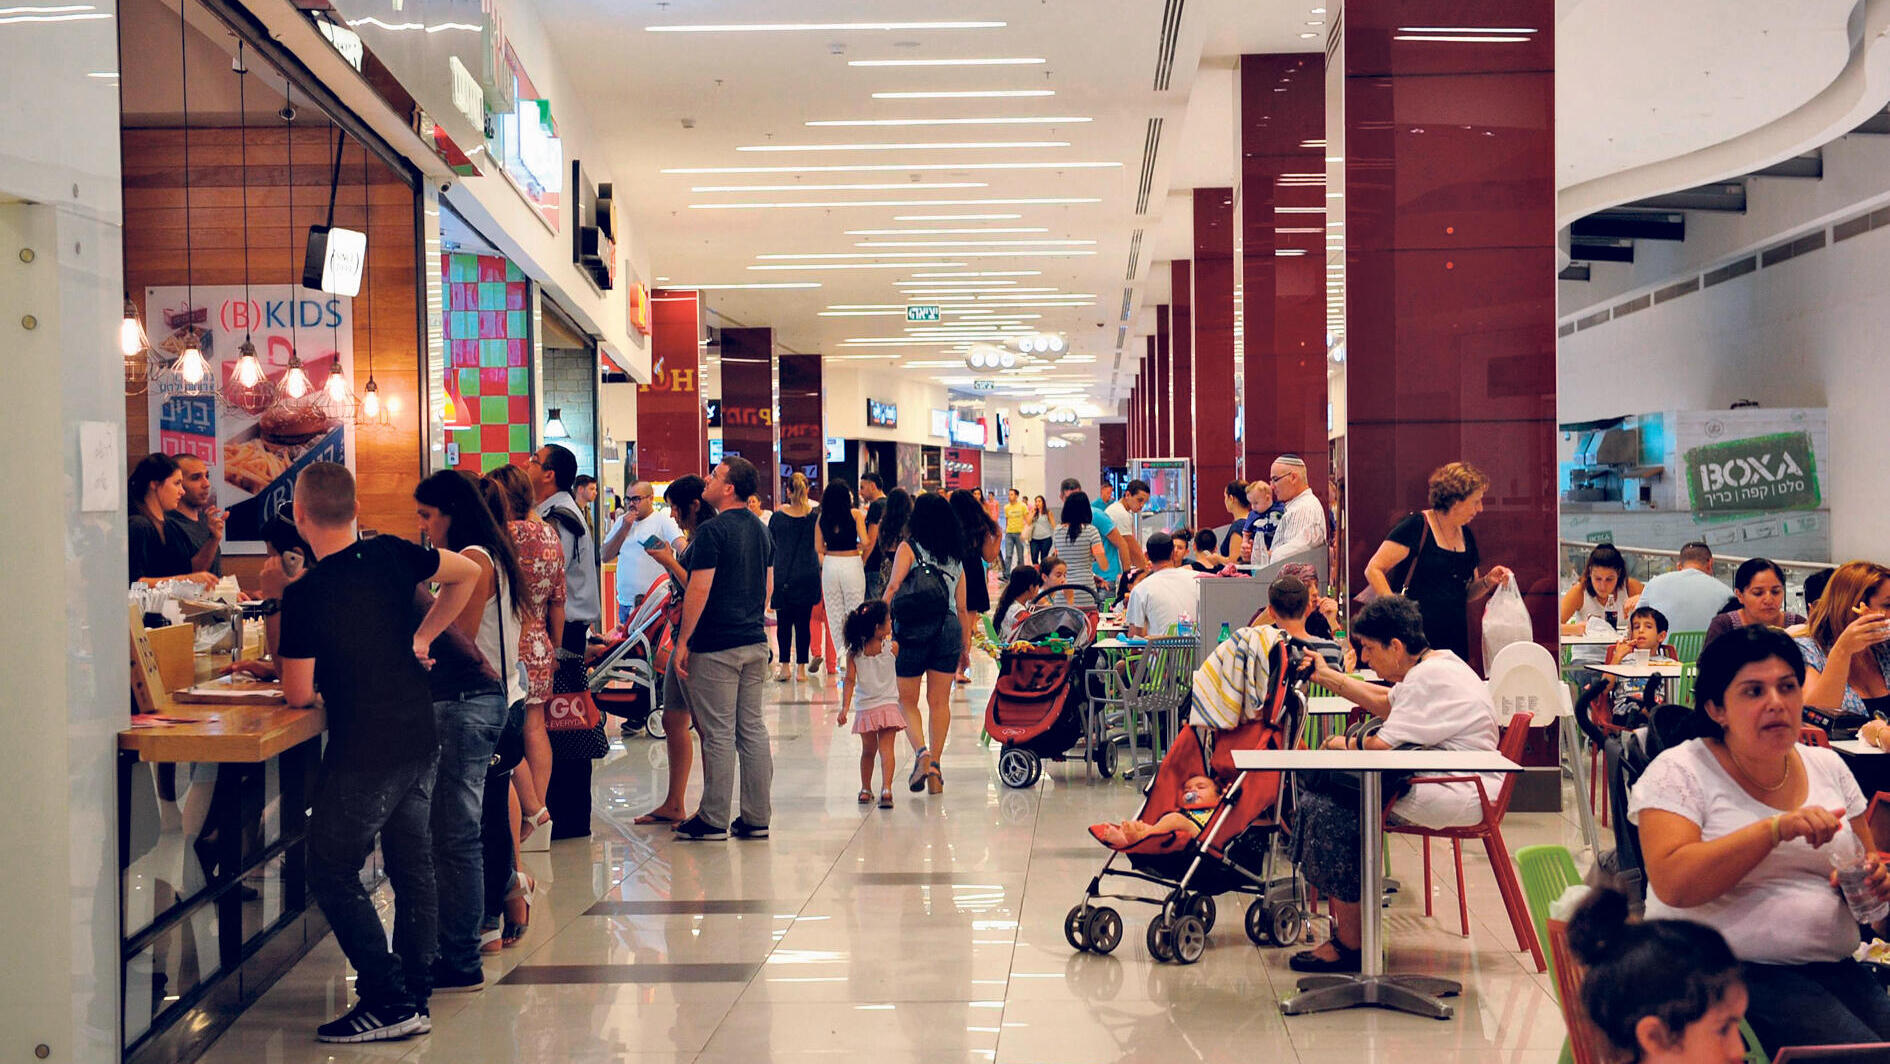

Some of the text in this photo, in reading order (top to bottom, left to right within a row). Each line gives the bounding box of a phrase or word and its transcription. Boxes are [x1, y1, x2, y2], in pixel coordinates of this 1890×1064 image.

[1700, 451, 1803, 492] BOXA
[1704, 480, 1805, 508] סלט קפה כריך
